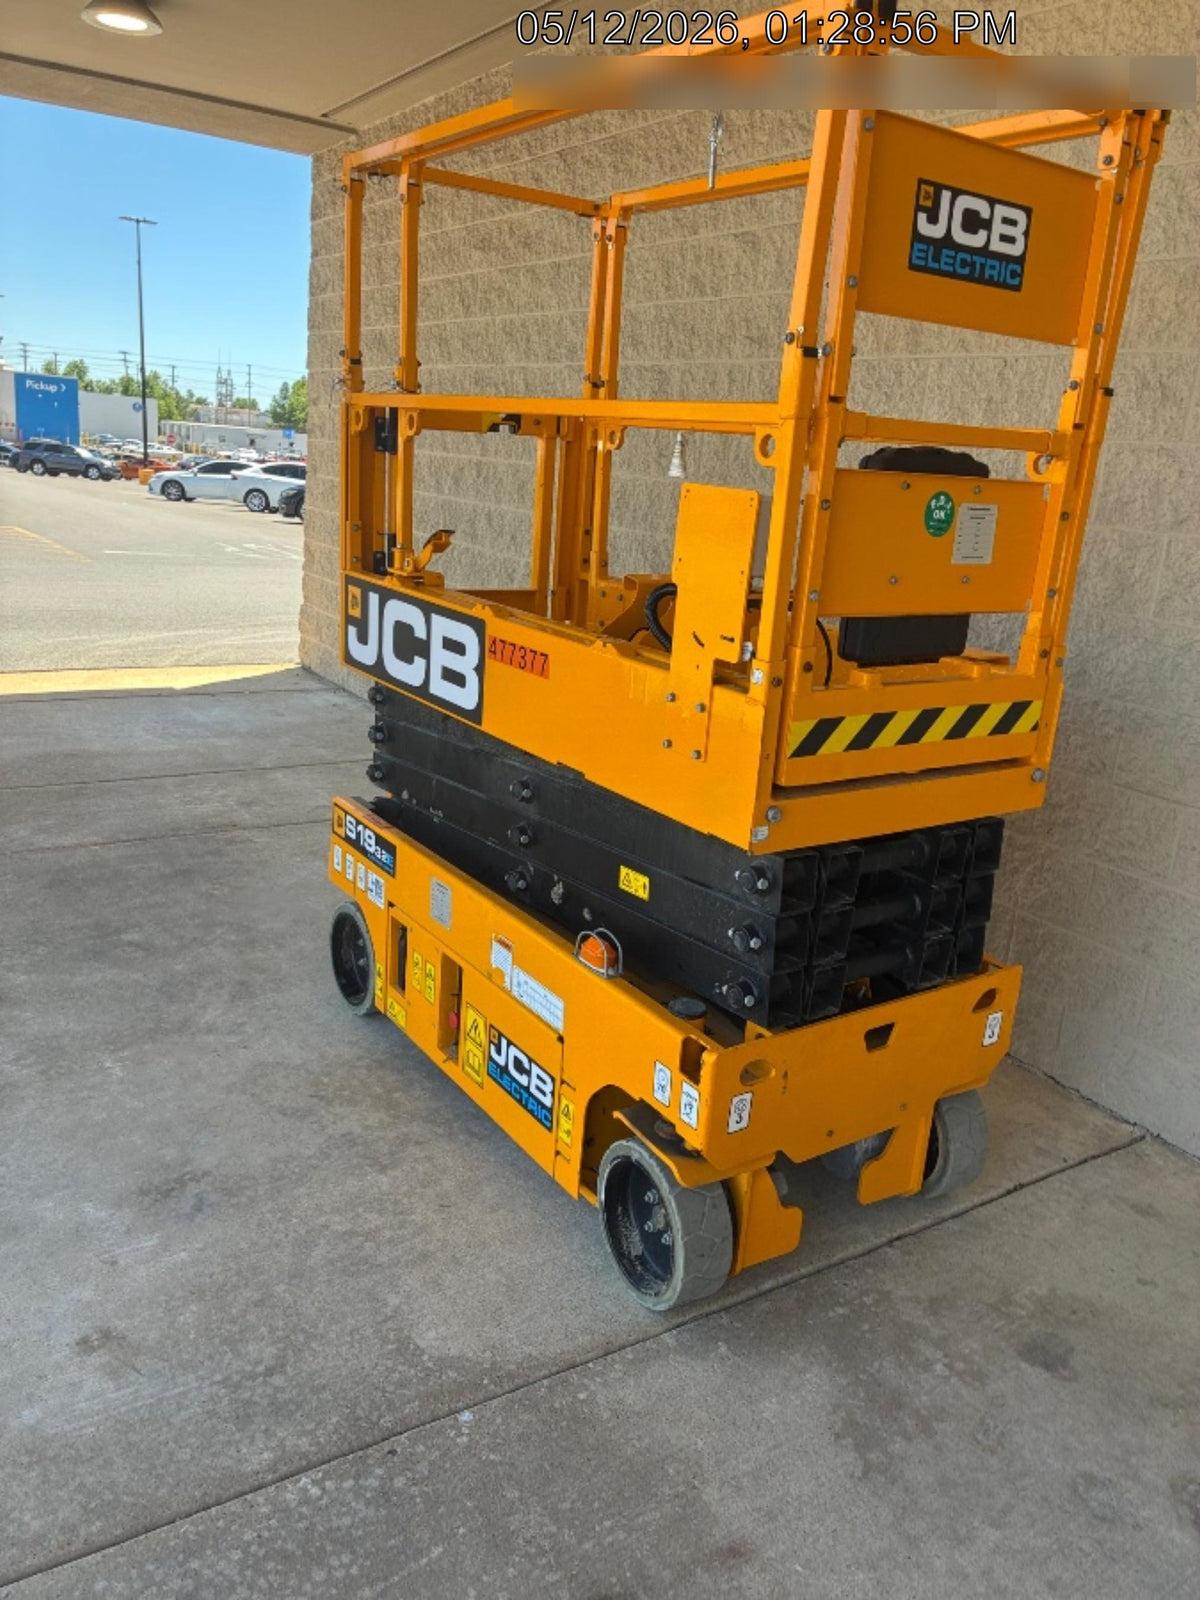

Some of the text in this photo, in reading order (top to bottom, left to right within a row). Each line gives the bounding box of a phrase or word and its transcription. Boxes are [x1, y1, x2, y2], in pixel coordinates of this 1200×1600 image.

[917, 188, 1029, 257] JCB
[911, 241, 1022, 286] ELECTRIC
[25, 379, 58, 394] Pickup
[347, 591, 481, 711] JCB
[488, 636, 549, 678] 477377
[487, 1061, 553, 1129] ELECTRIC
[489, 1035, 555, 1109] JCB
